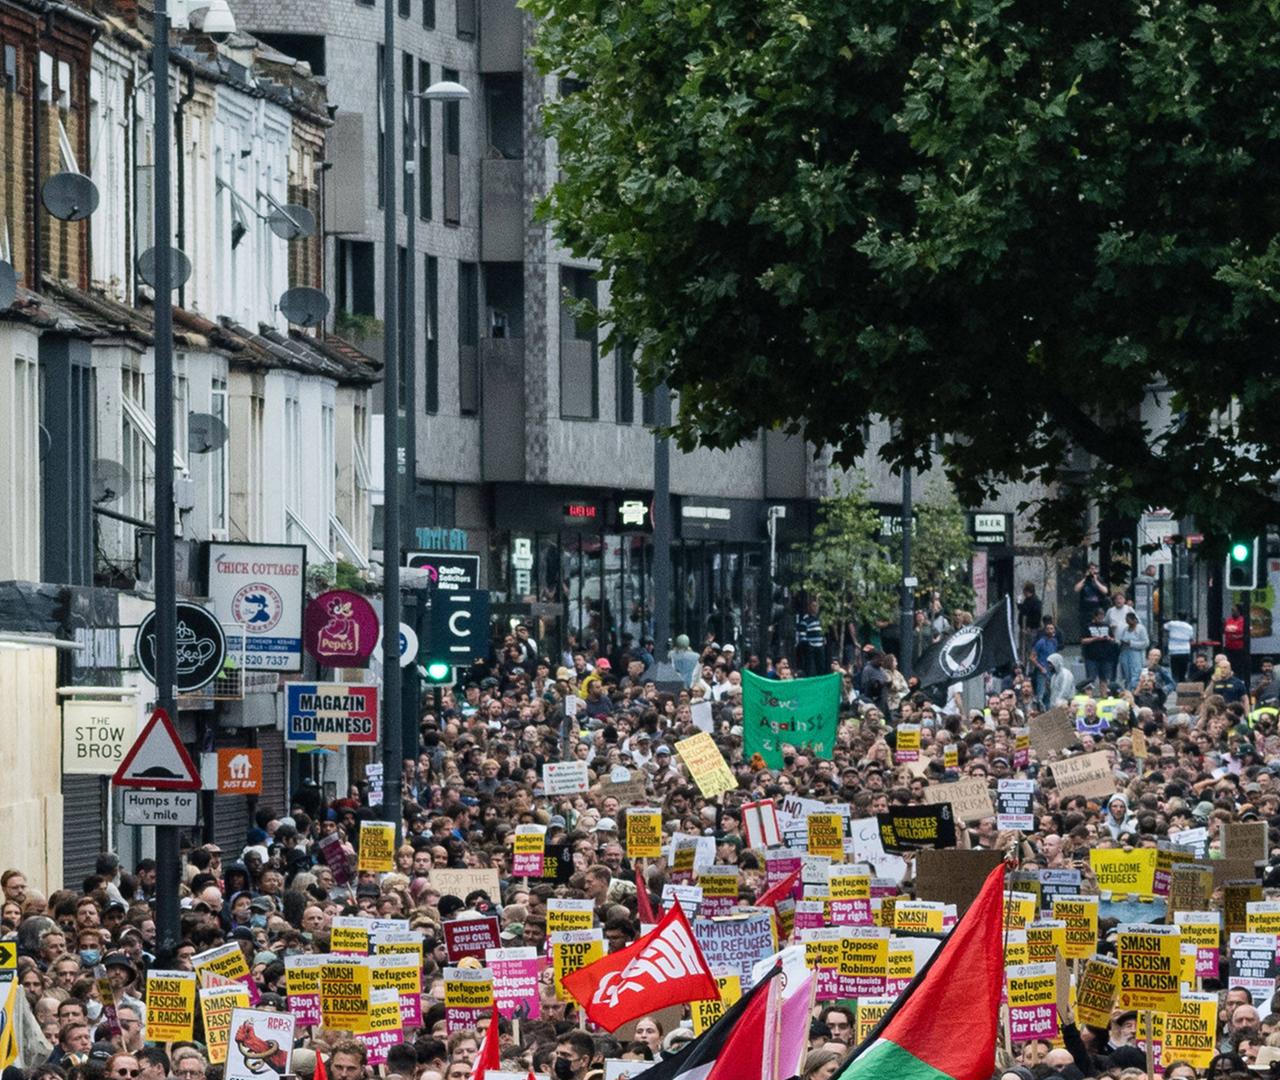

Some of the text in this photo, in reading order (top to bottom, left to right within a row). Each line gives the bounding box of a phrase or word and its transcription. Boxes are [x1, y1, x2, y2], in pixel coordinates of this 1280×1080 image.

[218, 562, 299, 576] CHICK COTTAGE
[439, 566, 465, 576] Quality
[322, 638, 353, 650] Pepe's
[300, 695, 365, 710] MAGAZIN
[91, 717, 110, 726] THE
[293, 717, 371, 733] ROMANESC
[75, 727, 124, 742] STOW
[77, 743, 123, 762] BROS
[223, 780, 258, 789] JUST EAT
[129, 795, 192, 809] Humps for
[155, 807, 178, 820] mile
[893, 816, 938, 830] REFUGEES
[895, 827, 938, 839] WELCOME
[1102, 863, 1141, 874] WELCOME
[1096, 873, 1137, 884] REFUGEES
[695, 919, 770, 937] IMMIGRANTS
[560, 944, 591, 954] STOP
[721, 936, 771, 951] REFUGEES
[842, 941, 879, 952] Oppose
[561, 955, 584, 966] THE
[842, 952, 876, 964] Tommy
[840, 963, 886, 974] Robinson
[149, 980, 180, 993] SMASH
[149, 996, 187, 1008] FASCISM
[148, 1010, 191, 1024] & RACISM
